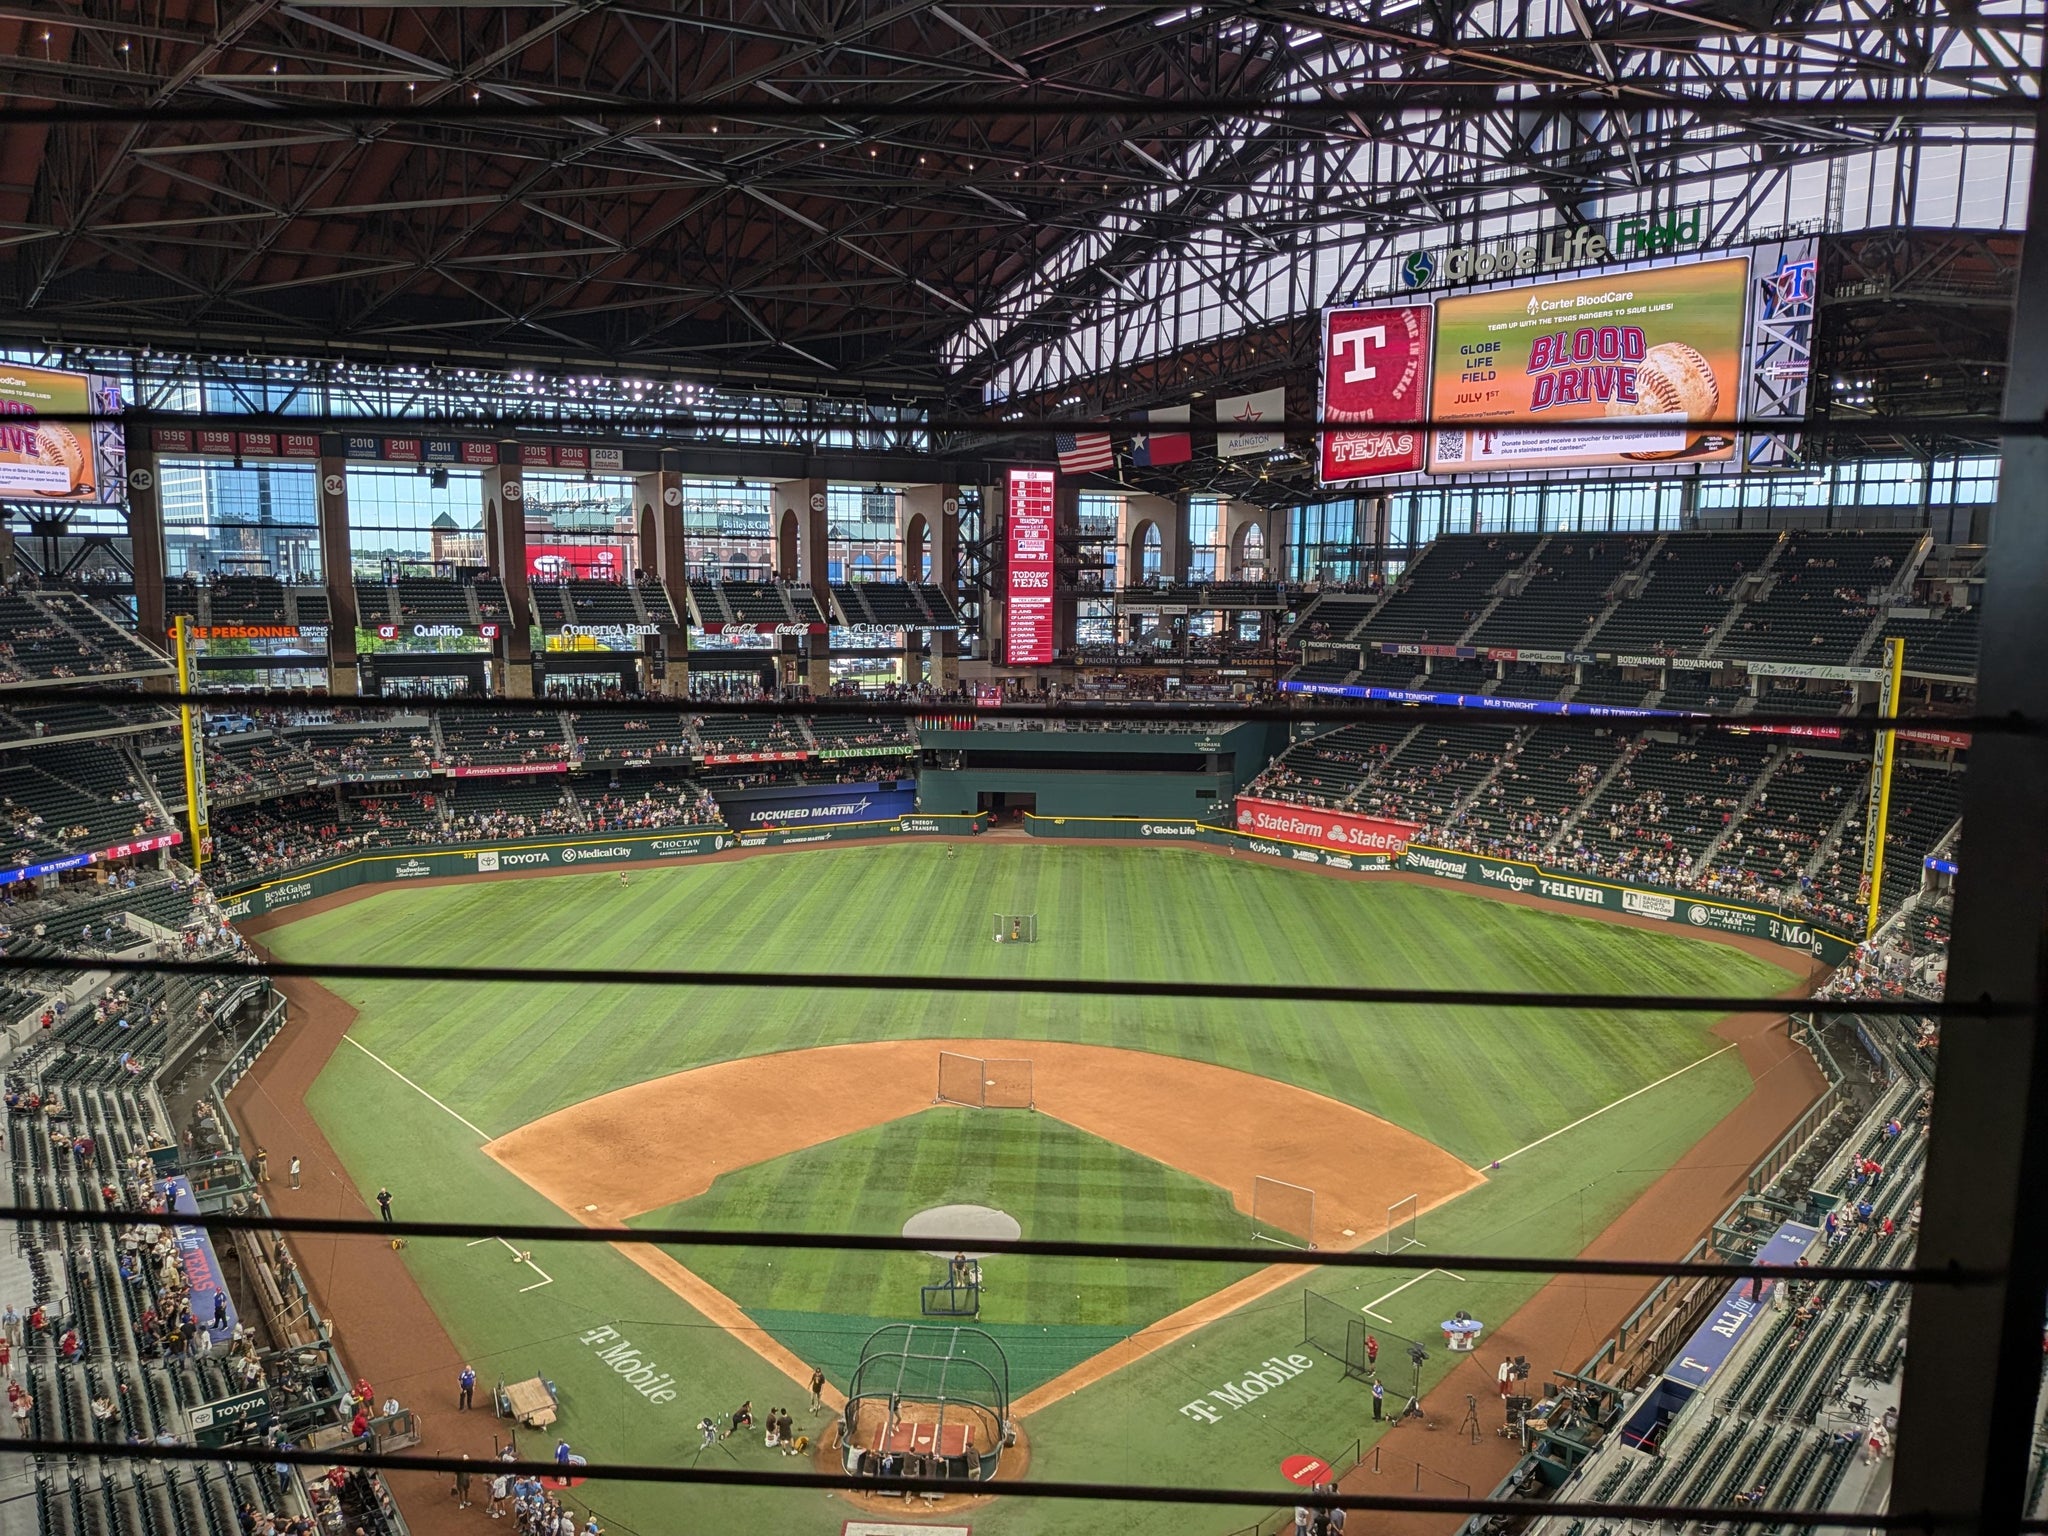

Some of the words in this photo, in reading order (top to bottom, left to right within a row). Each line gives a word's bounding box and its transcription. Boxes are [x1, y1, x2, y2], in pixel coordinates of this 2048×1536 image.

[1444, 242, 1537, 280] Globe
[1544, 226, 1607, 265] Life
[1616, 208, 1700, 254] Field
[1541, 300, 1575, 311] Carter
[1576, 292, 1634, 306] BloodCare
[1519, 319, 1538, 328] WITH
[1538, 317, 1552, 325] THE
[1554, 314, 1577, 323] TEXAS
[1578, 310, 1613, 319] RANGERS
[1615, 309, 1625, 317] TO
[1627, 305, 1647, 314] SAVE
[1649, 302, 1674, 312] LIVES!
[1401, 309, 1419, 338] TIME
[1409, 342, 1420, 356] IN
[1460, 342, 1501, 355] GLOBE
[1526, 326, 1647, 375] BLOOD
[1332, 325, 1386, 384] T
[1467, 357, 1492, 368] LIFE
[1392, 361, 1418, 400] TEXAS
[1462, 371, 1496, 383] FIELD
[1530, 365, 1639, 412] DRIVE
[1454, 392, 1482, 404] JULY
[1486, 390, 1500, 401] 1ST
[159, 430, 185, 441] 1996
[204, 432, 229, 443] 1998
[245, 434, 271, 444] 1999
[288, 436, 313, 446] 2010
[1624, 433, 1642, 442] upper
[350, 438, 374, 448] 2010
[392, 440, 413, 450] 2011
[430, 442, 451, 452] 2011
[1228, 434, 1271, 449] ARLINGTON
[468, 444, 491, 454] 2012
[524, 446, 547, 456] 2015
[561, 448, 583, 459] 2016
[1332, 434, 1413, 462] TEJAS
[1501, 447, 1513, 455] plus
[1519, 445, 1558, 453] stainless-steel
[595, 450, 619, 460] 2023
[132, 473, 149, 485] 42
[327, 480, 343, 491] 34
[504, 485, 520, 496] 26
[669, 491, 677, 502] 7
[812, 496, 824, 507] 29
[946, 502, 956, 512] 10
[1012, 579, 1048, 588] TEJAS
[167, 627, 208, 638] CRE
[212, 626, 300, 638] PERSONNEL
[380, 626, 394, 638] QT
[414, 624, 463, 638] QuikTrip
[482, 626, 495, 637] QT
[626, 623, 660, 635] Bank
[721, 623, 758, 636] Coca-Cola
[775, 623, 811, 636] Coca-Cola
[858, 622, 914, 633] CHOCTAW
[1332, 642, 1361, 650] COMMERCE
[1397, 645, 1419, 654] 105.3
[1496, 650, 1515, 659] PGL
[1519, 652, 1562, 662] GoPGL.com
[1573, 654, 1595, 663] PGL
[1617, 655, 1666, 666] BODYARMOR
[1672, 658, 1724, 669] BODYARMOR
[1750, 662, 1777, 674] Blue
[1781, 664, 1814, 676] Mint
[1318, 686, 1344, 694] TONIGHT
[1388, 691, 1403, 699] MLB
[1405, 693, 1434, 702] TONIGHT
[1484, 699, 1500, 707] MLB
[1502, 700, 1535, 710] TONIGHT
[1876, 674, 1891, 763] CHIIN
[1790, 726, 1813, 735] 59.6
[829, 749, 863, 758] LUXOR
[865, 746, 912, 756] STAFFING
[465, 766, 506, 776] America's
[507, 765, 524, 774] Best
[525, 764, 558, 773] Network
[751, 809, 810, 822] LOCKHEED
[811, 805, 854, 817] MARTIN
[1153, 826, 1178, 835] Globe
[1180, 826, 1196, 835] Life
[783, 836, 806, 844] LOCKHEED
[807, 835, 825, 843] MARTIN
[1866, 809, 1878, 868] FARE
[655, 839, 701, 850] CHOCTAW
[1250, 841, 1281, 857] Kubota
[502, 852, 550, 865] TOYOTA
[578, 848, 613, 859] Medical
[613, 847, 632, 857] City
[40, 864, 54, 873] MLB
[55, 858, 81, 870] TONIGHT
[1419, 854, 1467, 874] National
[1434, 868, 1444, 877] Car
[1445, 870, 1464, 879] Rental
[1495, 866, 1535, 892] Kroger
[1625, 892, 1638, 907] T
[1642, 895, 1671, 905] RANGERS
[1642, 900, 1665, 908] SPORTS
[1642, 905, 1672, 914] NETWORK
[1710, 908, 1731, 917] EAST
[1732, 911, 1756, 922] TEXAS
[1722, 917, 1743, 926] A&M
[1709, 921, 1755, 934] UNIVERSITY
[183, 1248, 215, 1292] TEXAS
[1712, 1311, 1748, 1338] ALL
[1680, 1356, 1710, 1373] T
[216, 1397, 266, 1418] TOYOTA
